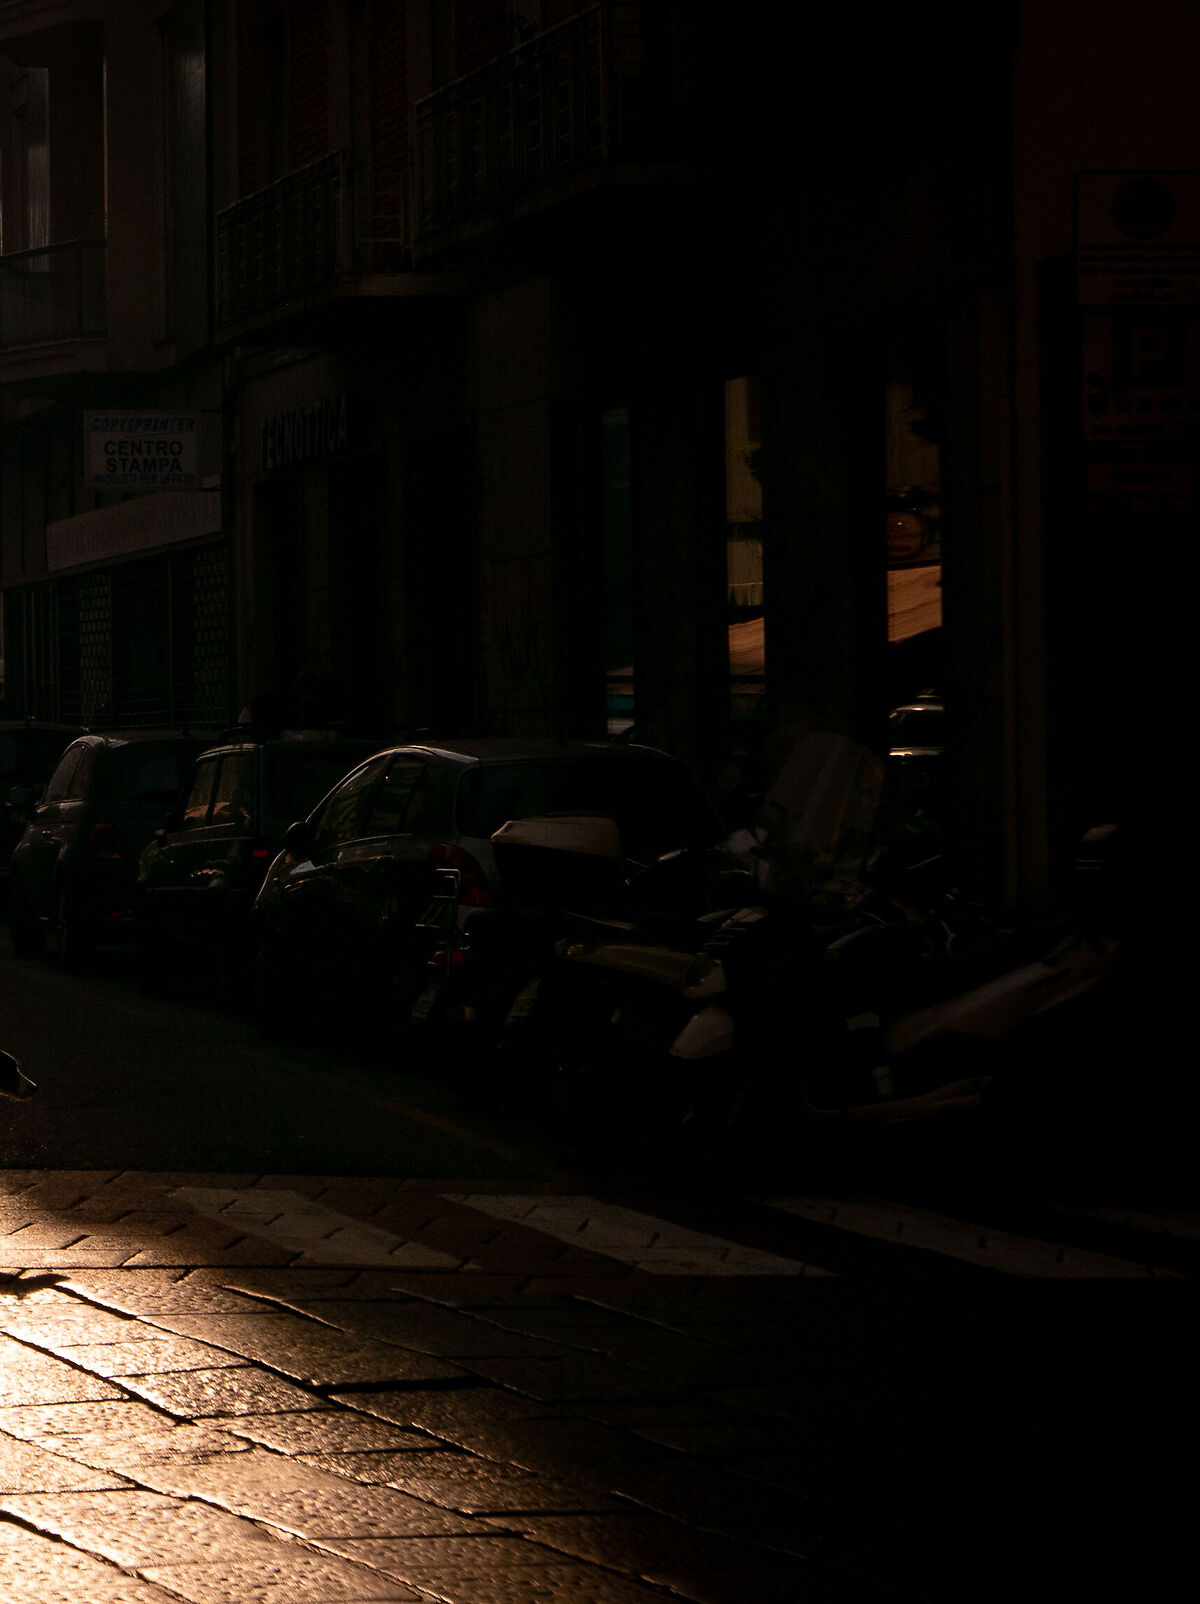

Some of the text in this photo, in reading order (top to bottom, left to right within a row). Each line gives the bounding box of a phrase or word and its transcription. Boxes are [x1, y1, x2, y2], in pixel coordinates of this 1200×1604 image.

[104, 440, 183, 456] CENTRO
[106, 457, 182, 473] STAMPA
[140, 473, 159, 485] PER
